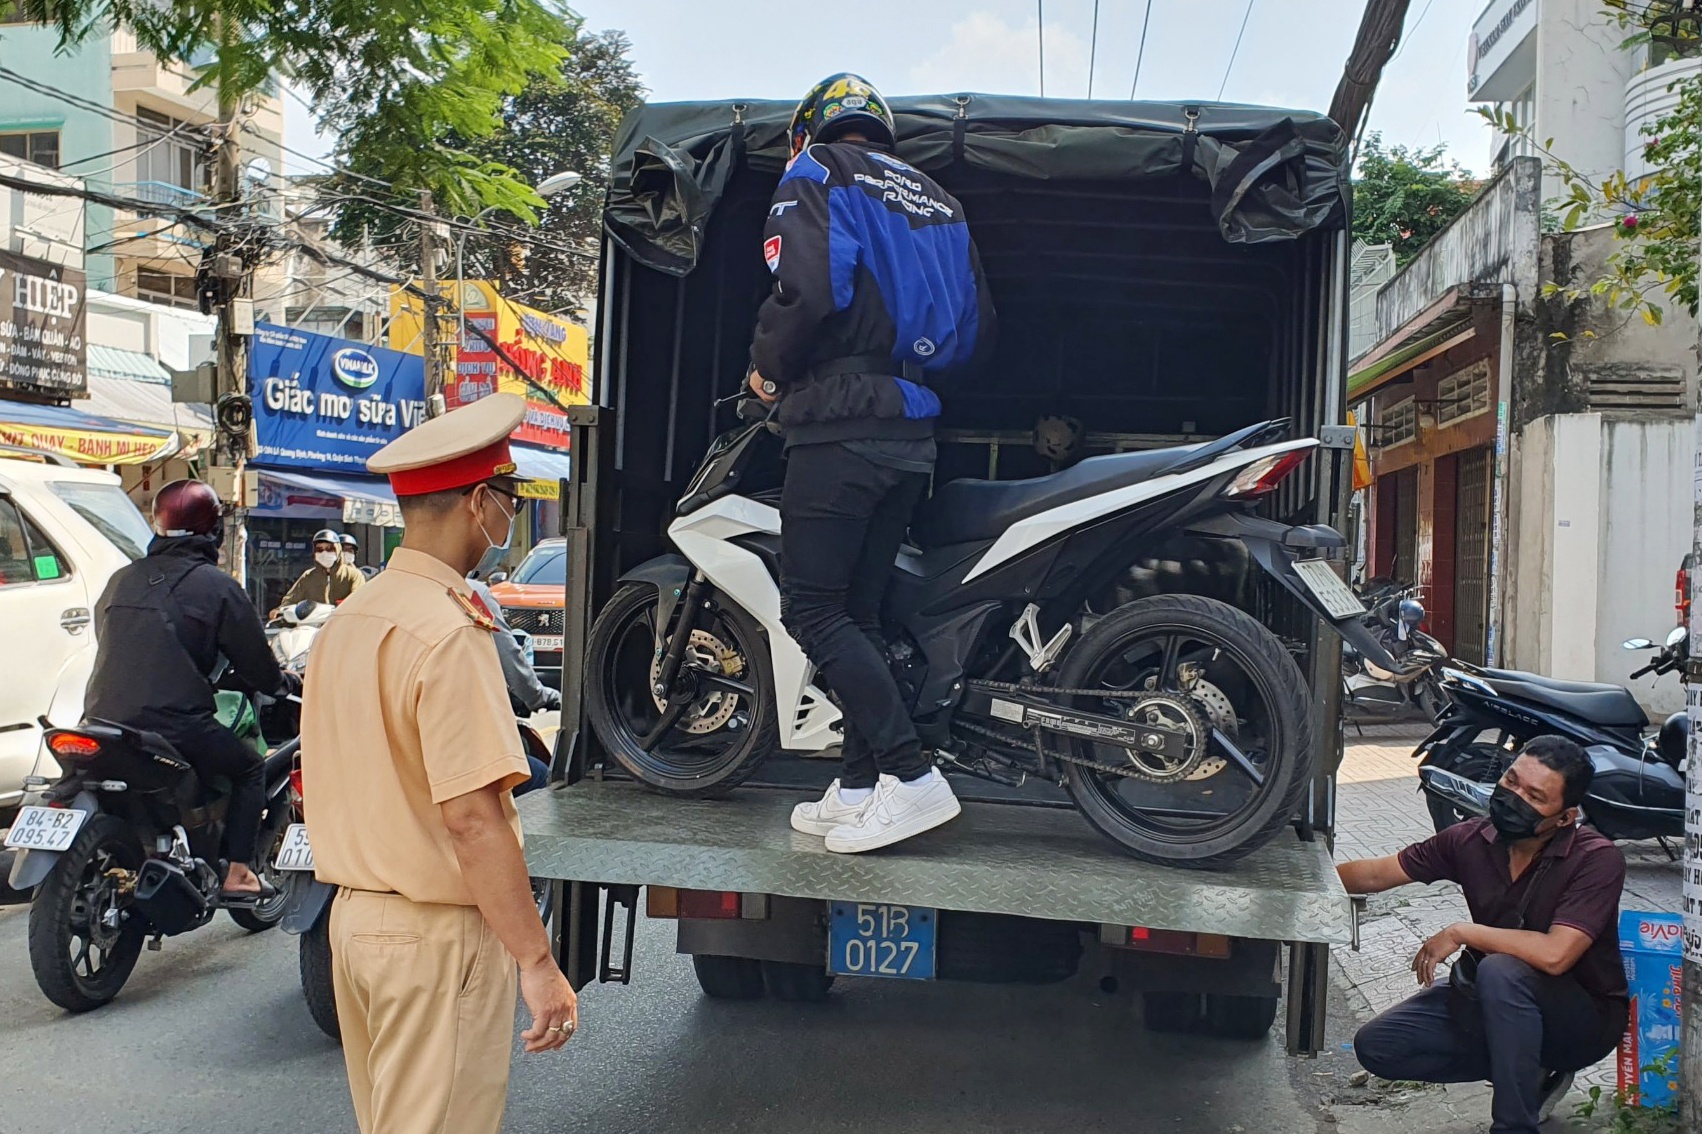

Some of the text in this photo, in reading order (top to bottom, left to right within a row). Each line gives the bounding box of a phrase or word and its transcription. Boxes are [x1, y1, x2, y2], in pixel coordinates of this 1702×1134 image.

[884, 169, 921, 191] FORD
[854, 173, 953, 218] PERFORMANCE
[883, 191, 935, 217] RACING
[265, 372, 314, 415] Giấc
[359, 394, 396, 426] sữa
[26, 810, 74, 829] 84-B2
[13, 828, 70, 847] 095.47
[857, 904, 909, 938] 51B
[846, 939, 919, 974] 0127
